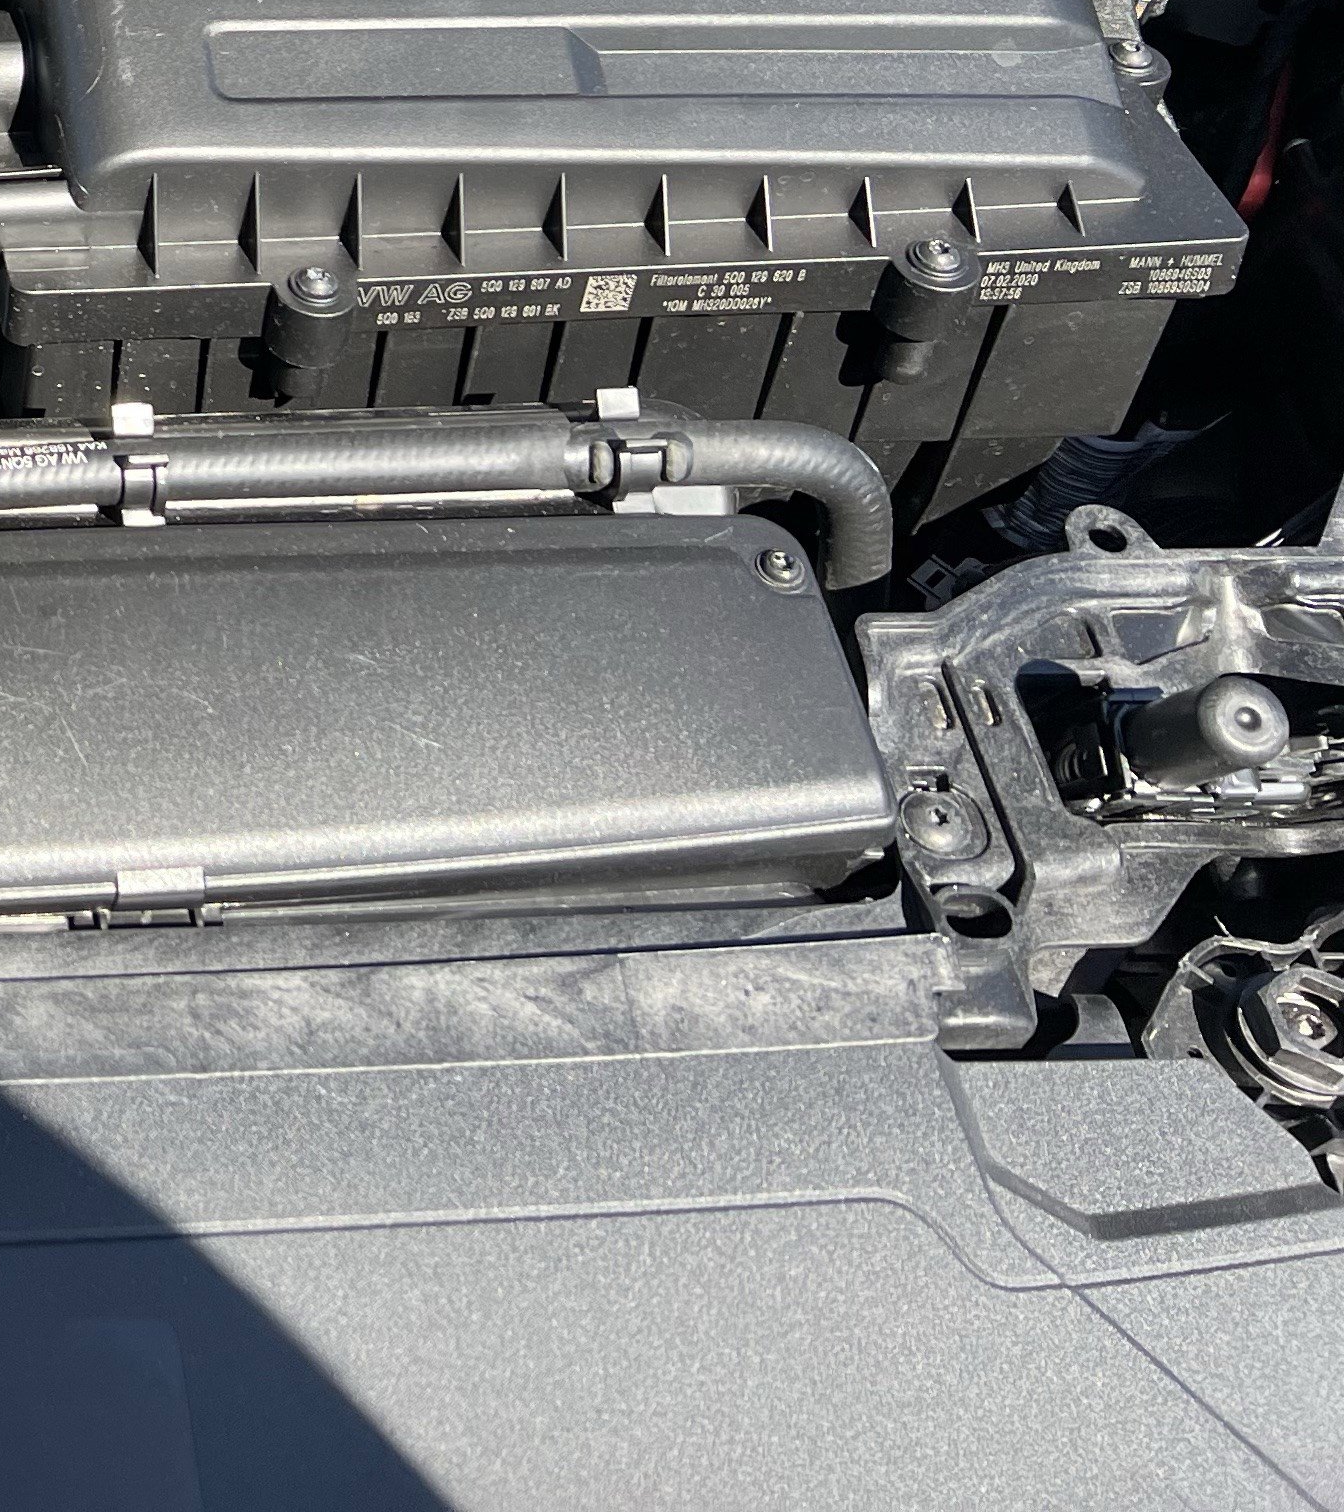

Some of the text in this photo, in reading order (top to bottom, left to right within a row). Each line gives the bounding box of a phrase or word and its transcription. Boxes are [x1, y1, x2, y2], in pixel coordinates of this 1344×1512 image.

[1014, 260, 1049, 273] United
[1054, 259, 1101, 274] Kingdom
[1129, 256, 1163, 269] MANN
[357, 281, 473, 308] VW AG
[35, 453, 58, 467] AG
[61, 450, 88, 464] VW
